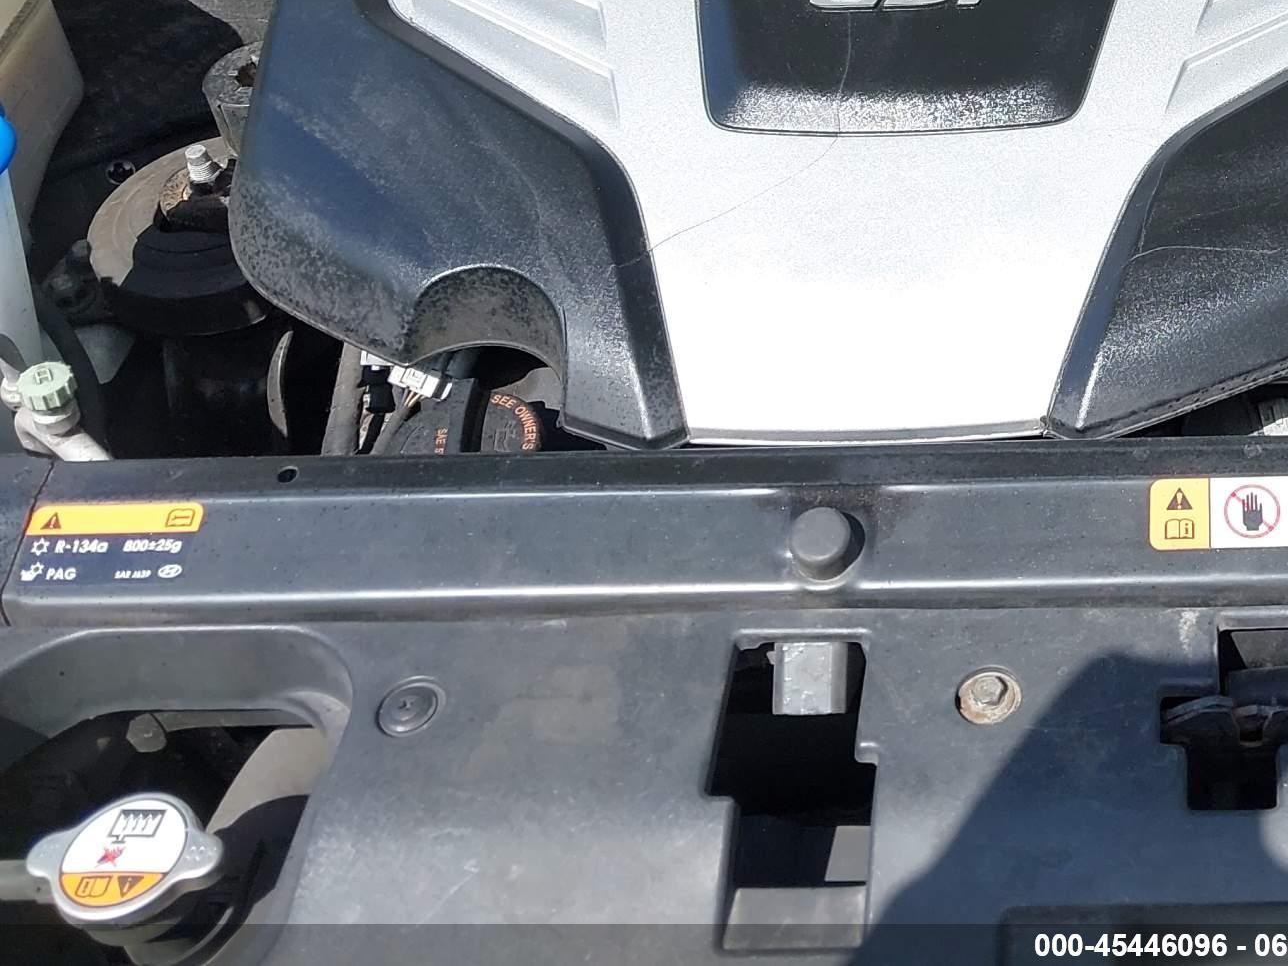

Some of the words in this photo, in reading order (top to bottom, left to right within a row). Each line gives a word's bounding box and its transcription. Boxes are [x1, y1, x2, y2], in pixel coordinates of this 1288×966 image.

[491, 394, 517, 409] SEE
[514, 405, 537, 451] OWNER'S
[54, 539, 109, 554] R-134a
[46, 567, 77, 581] PAG
